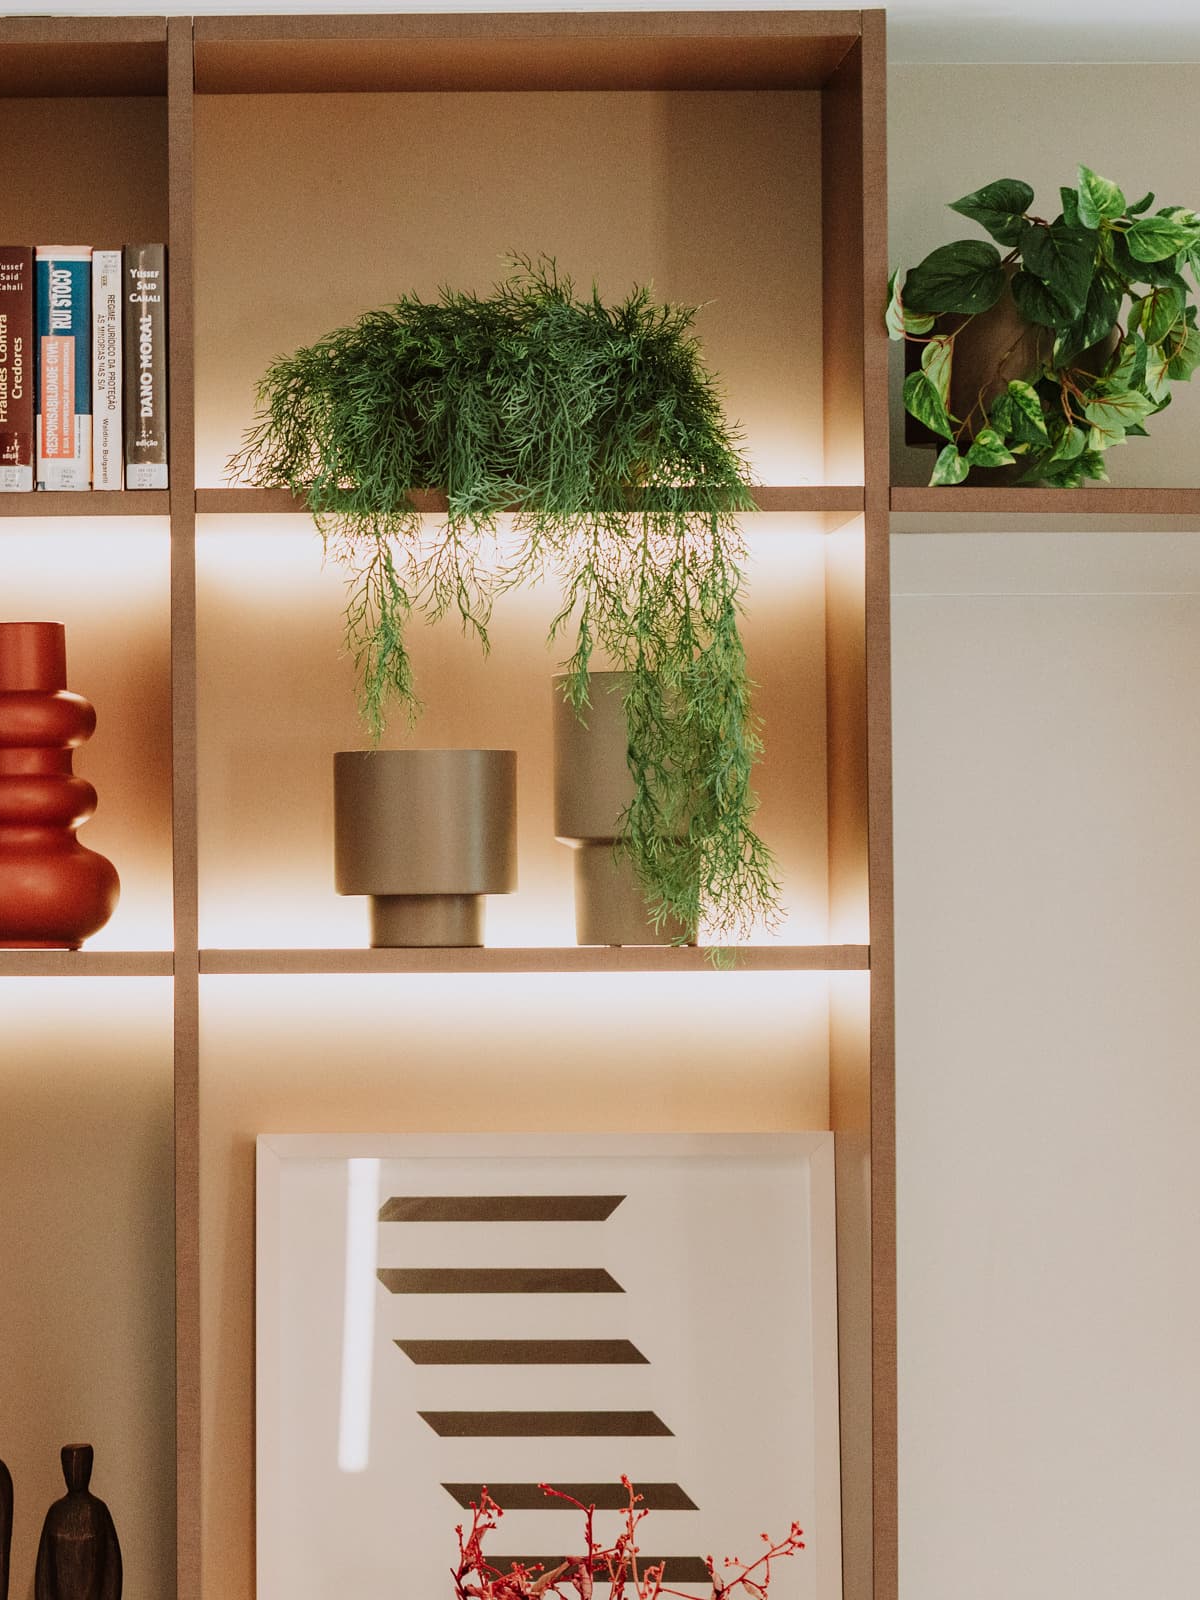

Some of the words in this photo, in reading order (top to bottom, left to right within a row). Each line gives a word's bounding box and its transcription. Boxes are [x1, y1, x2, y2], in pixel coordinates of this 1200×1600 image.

[0, 272, 19, 281] Said
[51, 269, 72, 307] STOCO
[51, 309, 72, 329] RUI
[107, 295, 116, 321] REGIME
[46, 341, 58, 364] CIVIL
[107, 324, 118, 357] JURÍDICO
[139, 314, 152, 369] MORAL
[11, 337, 23, 399] Credores
[97, 362, 106, 377] NAS
[107, 359, 116, 369] DA
[97, 379, 106, 391] S/A
[106, 371, 118, 410] PROTEÇÃO
[140, 373, 153, 417] DANO
[46, 367, 59, 455] RESPONSABILIDADE
